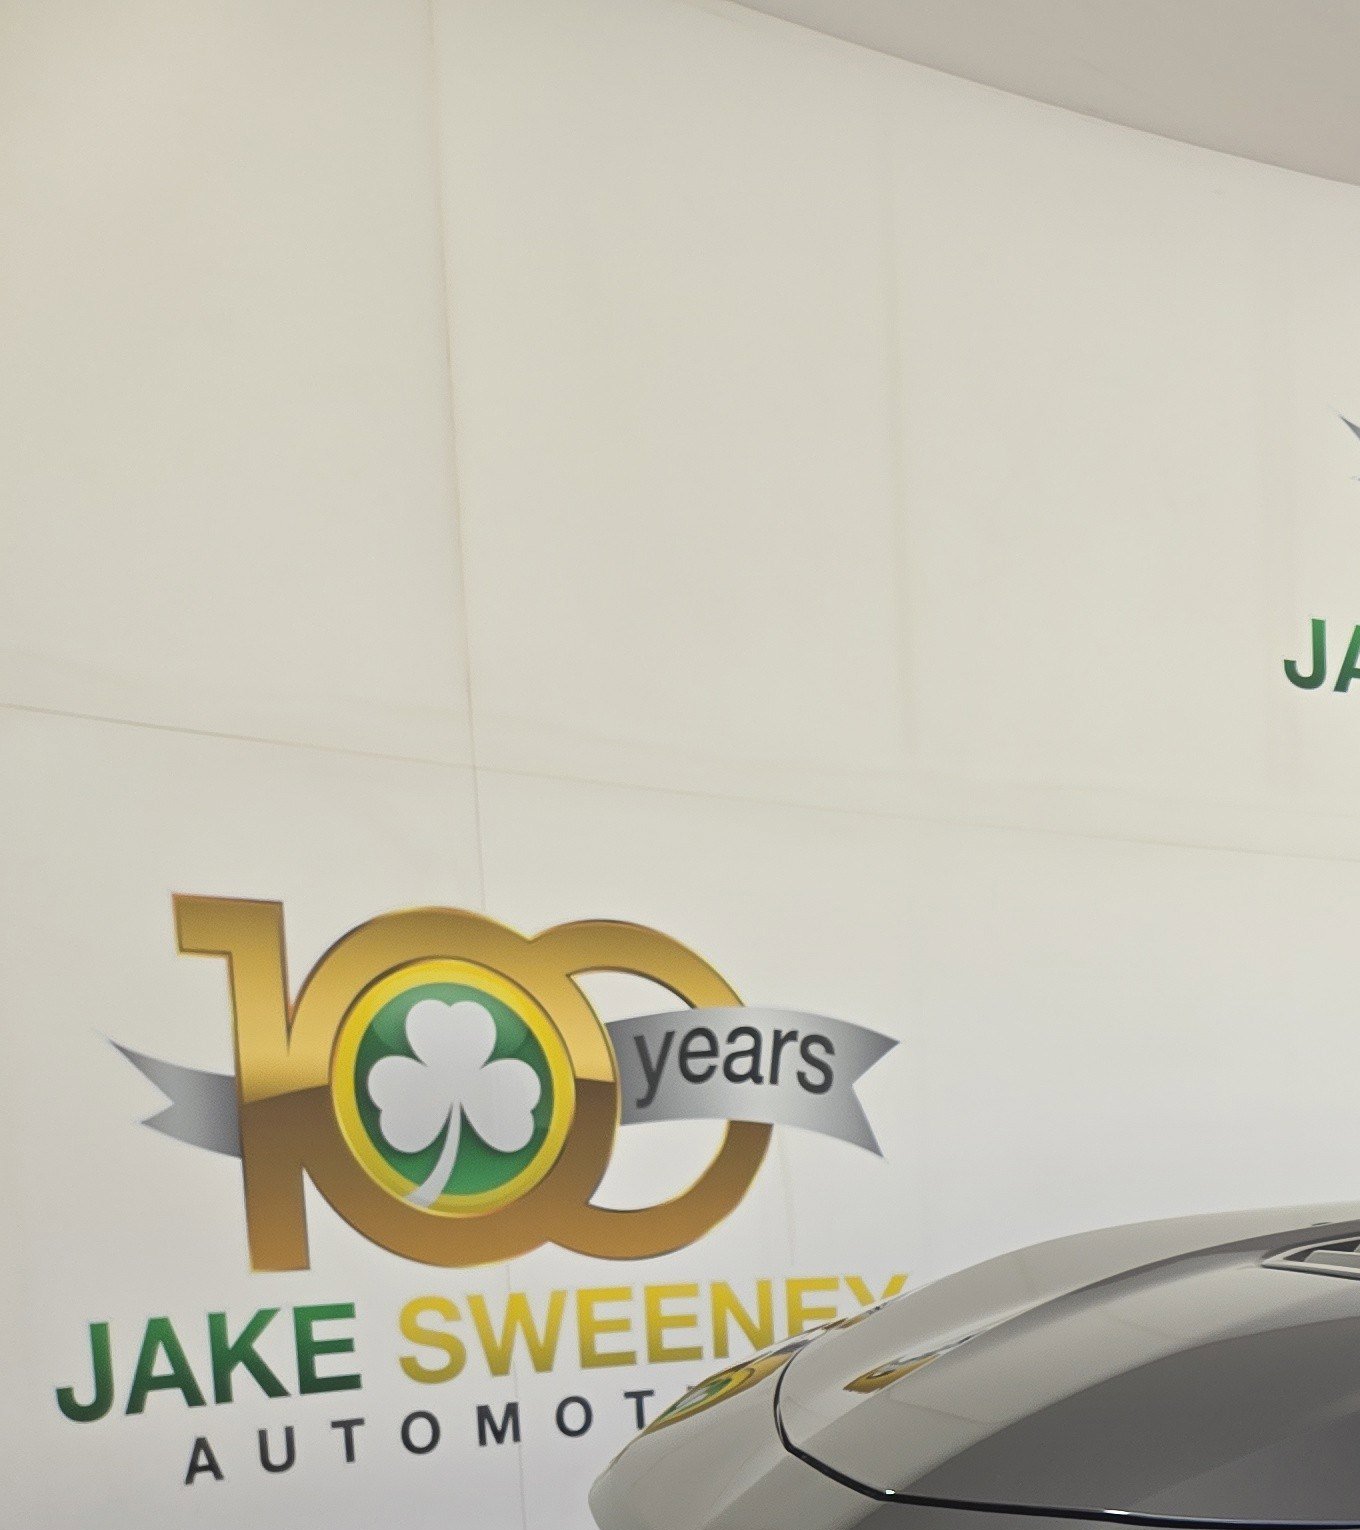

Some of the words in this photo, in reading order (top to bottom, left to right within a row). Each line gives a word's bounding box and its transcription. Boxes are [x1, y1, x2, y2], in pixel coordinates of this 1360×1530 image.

[631, 1024, 836, 1109] years
[55, 1301, 363, 1423] JAKE
[184, 1387, 699, 1485] AUTOMOT
